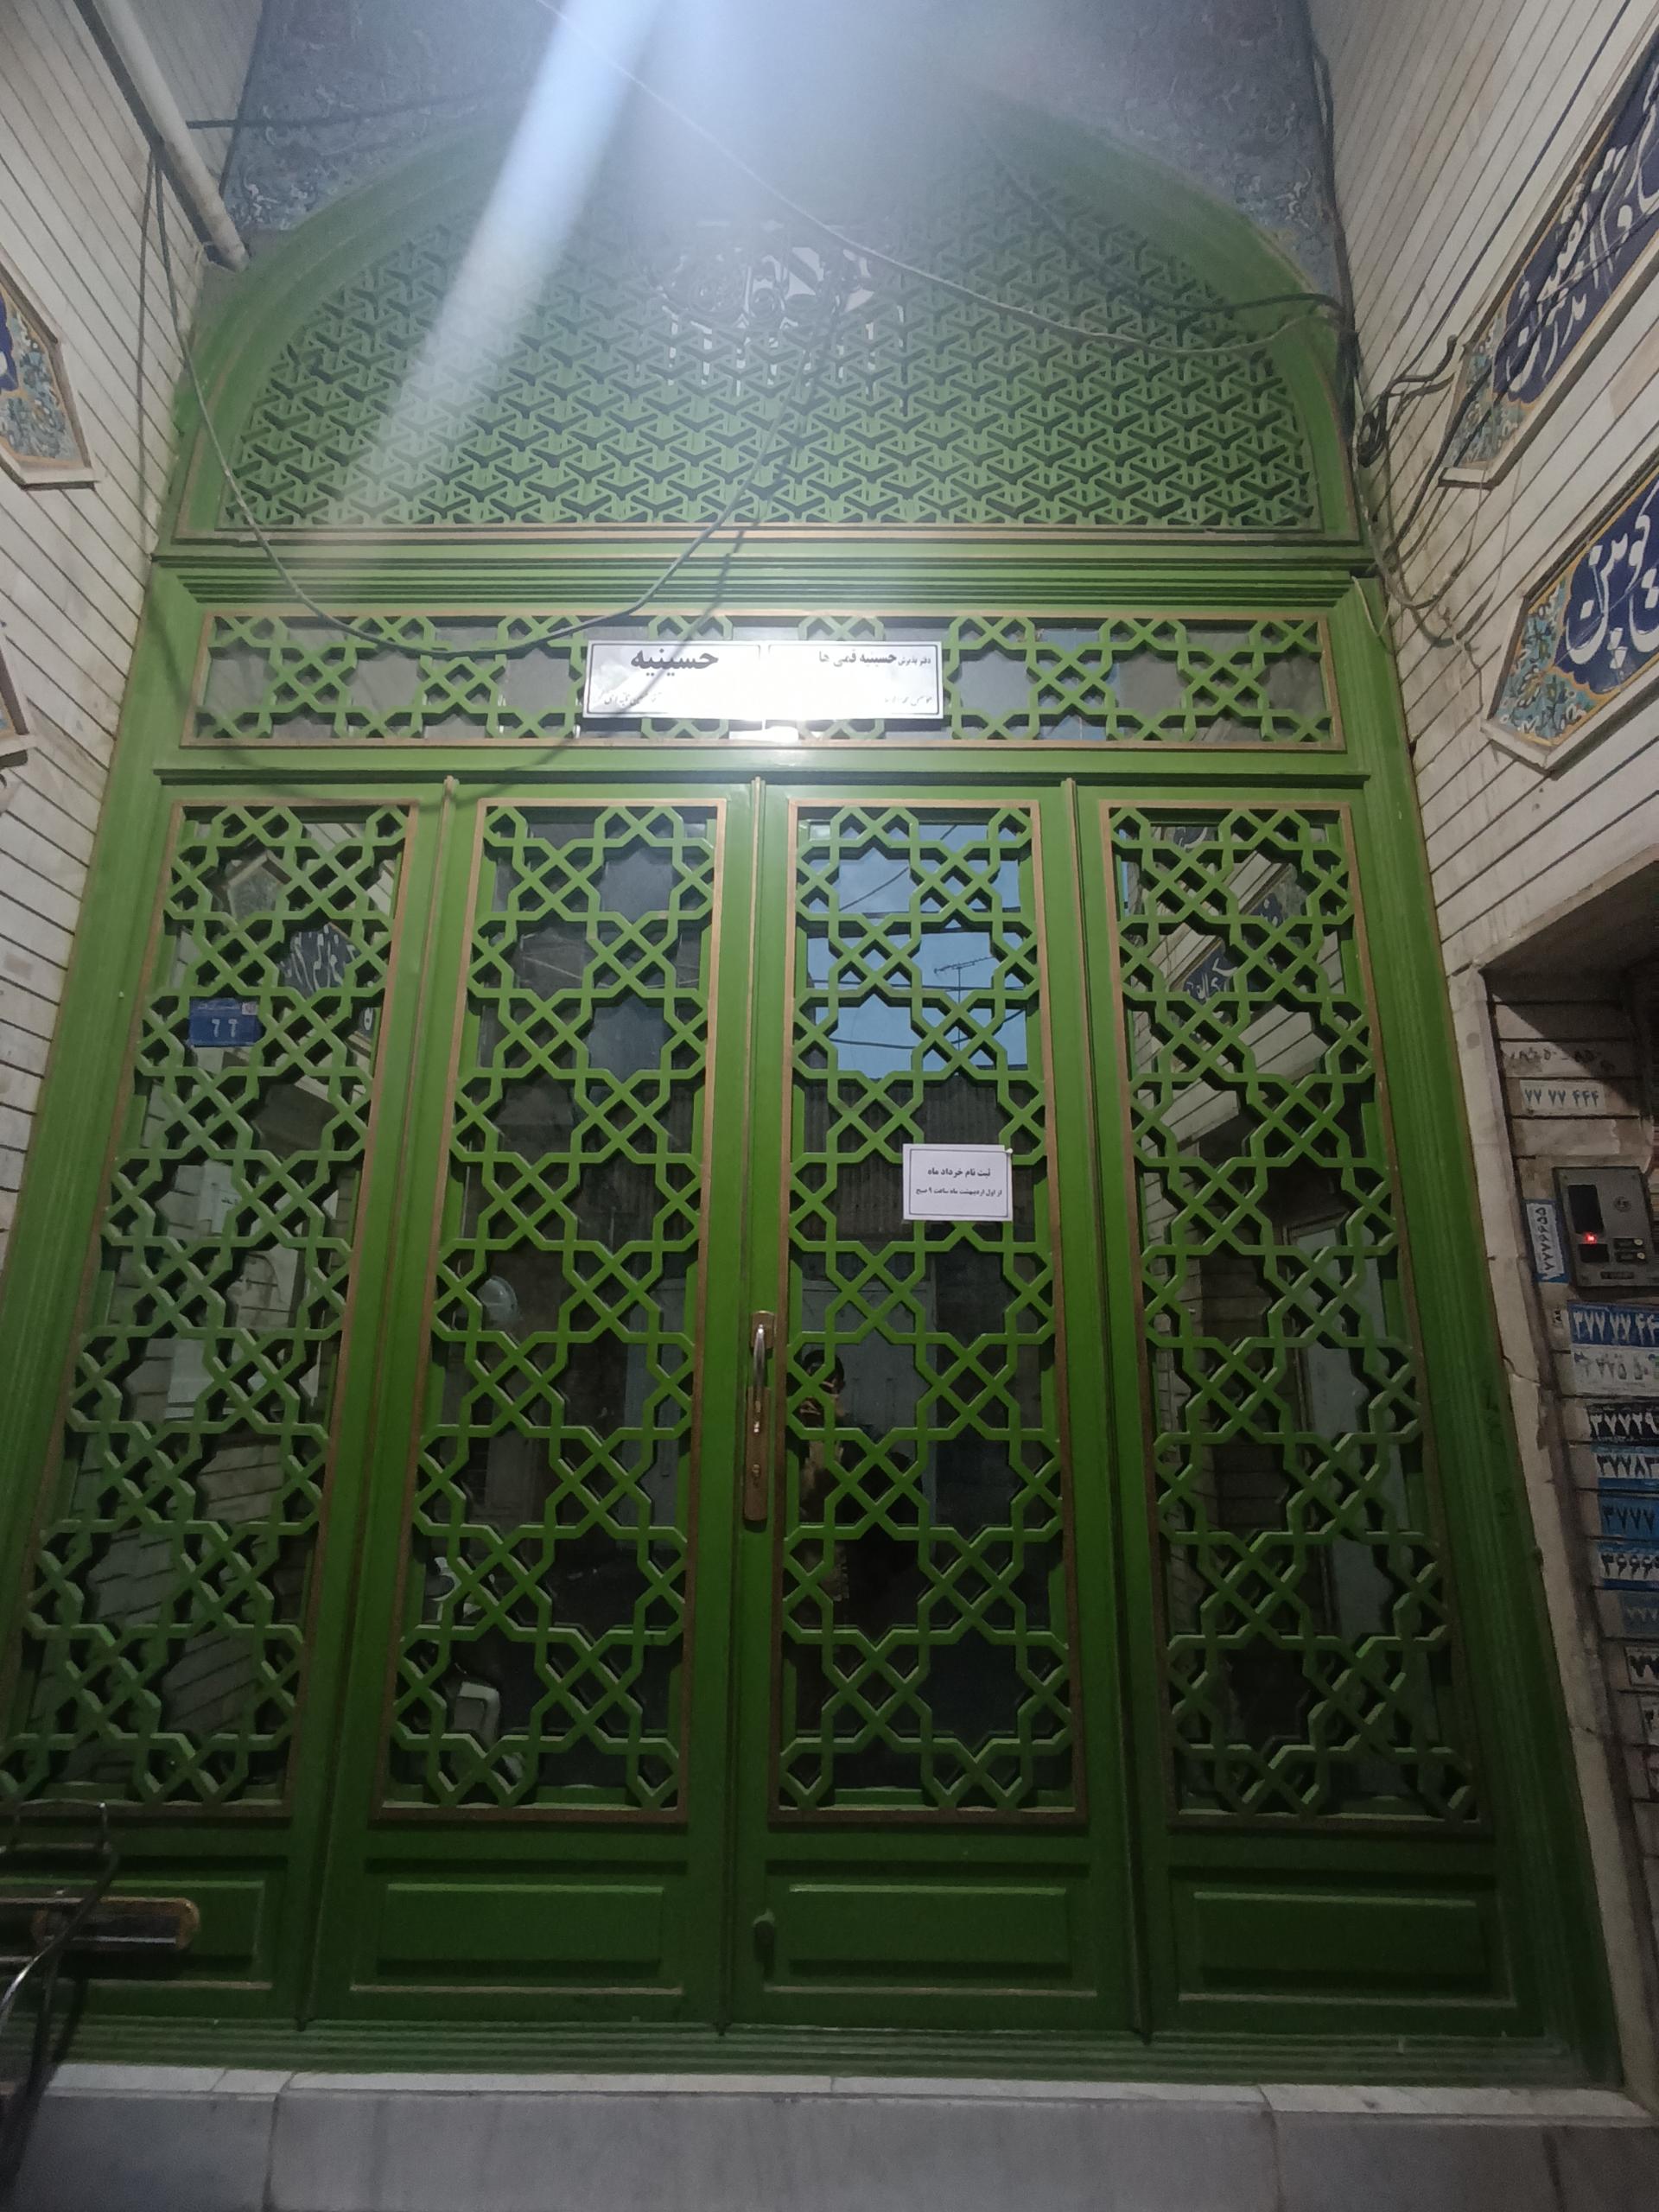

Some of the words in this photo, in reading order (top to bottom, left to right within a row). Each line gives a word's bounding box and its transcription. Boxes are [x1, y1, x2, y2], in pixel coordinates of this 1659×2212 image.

[631, 648, 719, 677] حسینیه
[819, 651, 830, 663] ها
[860, 652, 897, 668] حسینیه
[940, 1167, 963, 1179] خرداد
[965, 1168, 976, 1178] نام
[977, 1168, 991, 1179] ثبت
